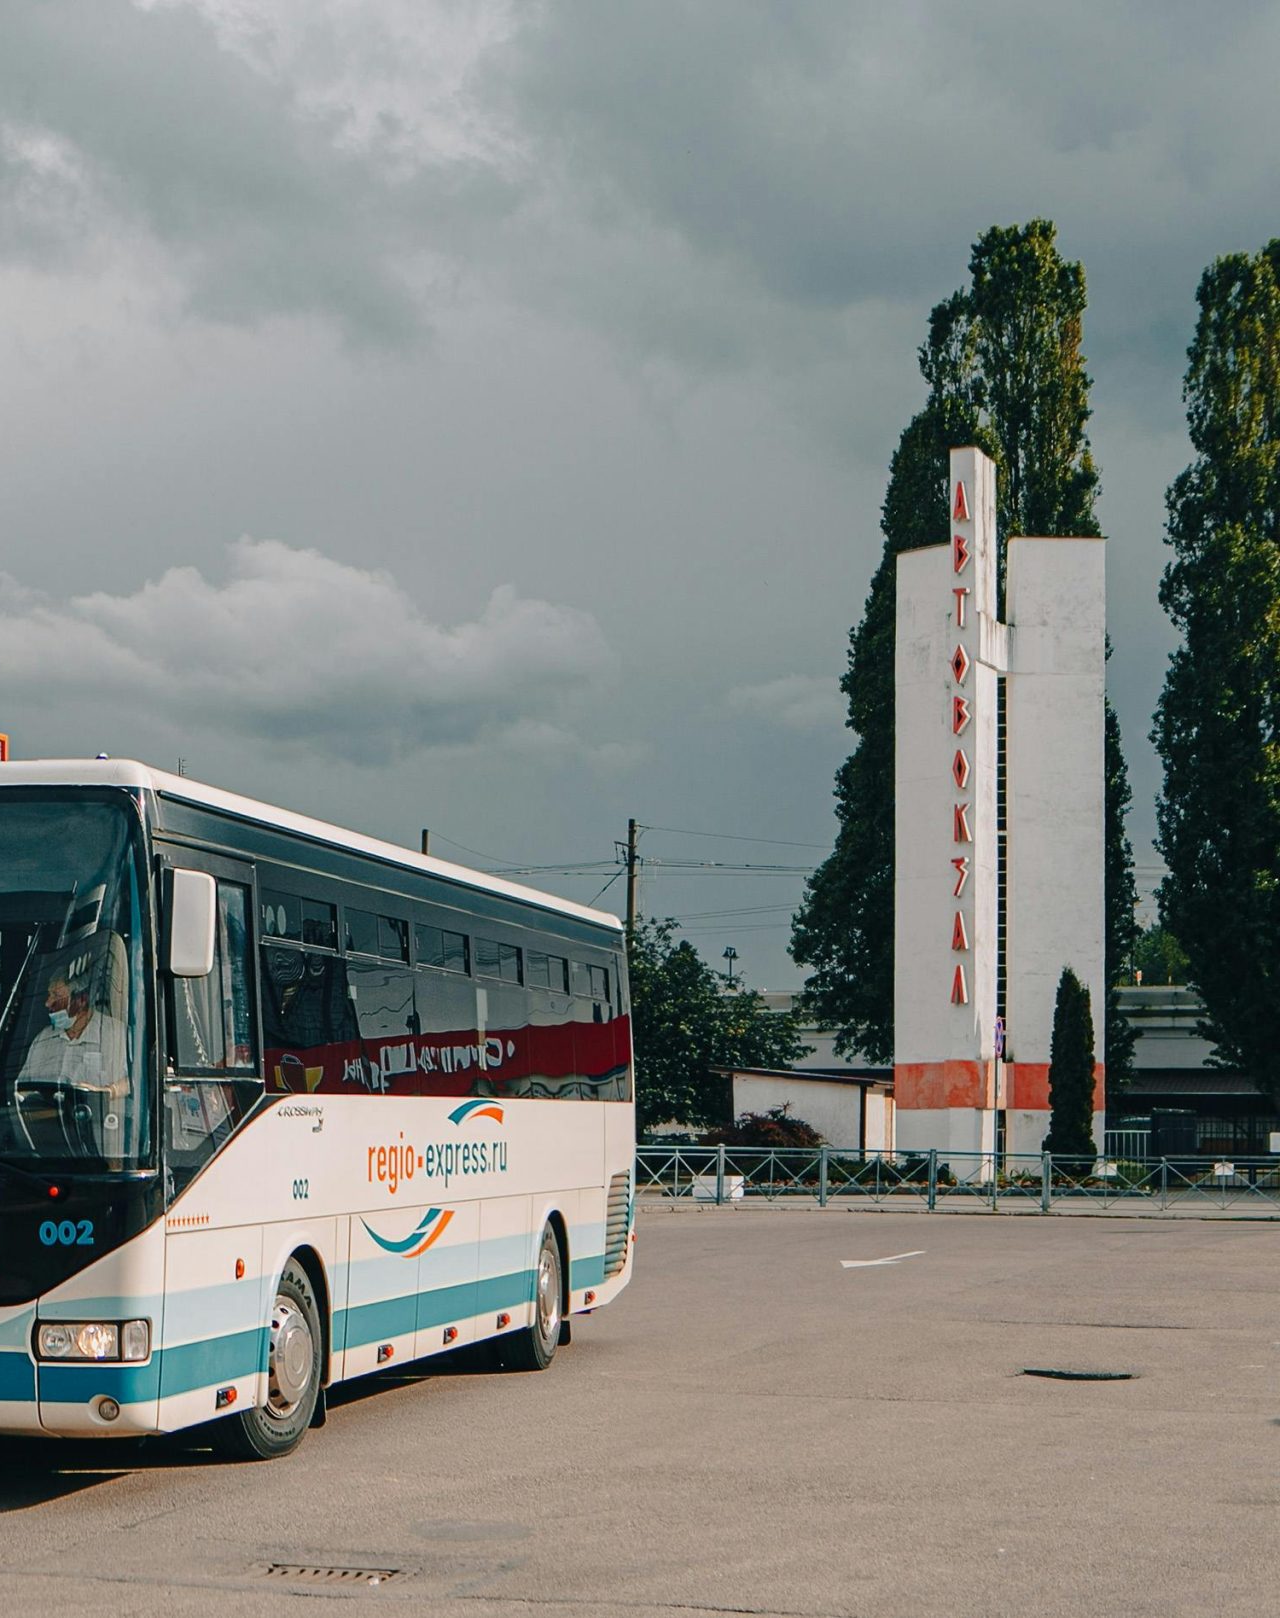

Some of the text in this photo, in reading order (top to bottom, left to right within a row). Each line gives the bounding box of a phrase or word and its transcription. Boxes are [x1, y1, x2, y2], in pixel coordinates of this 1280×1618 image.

[951, 480, 972, 1005] АВТОВОКЗАЛ
[293, 1178, 309, 1199] 002
[39, 1220, 95, 1246] 002
